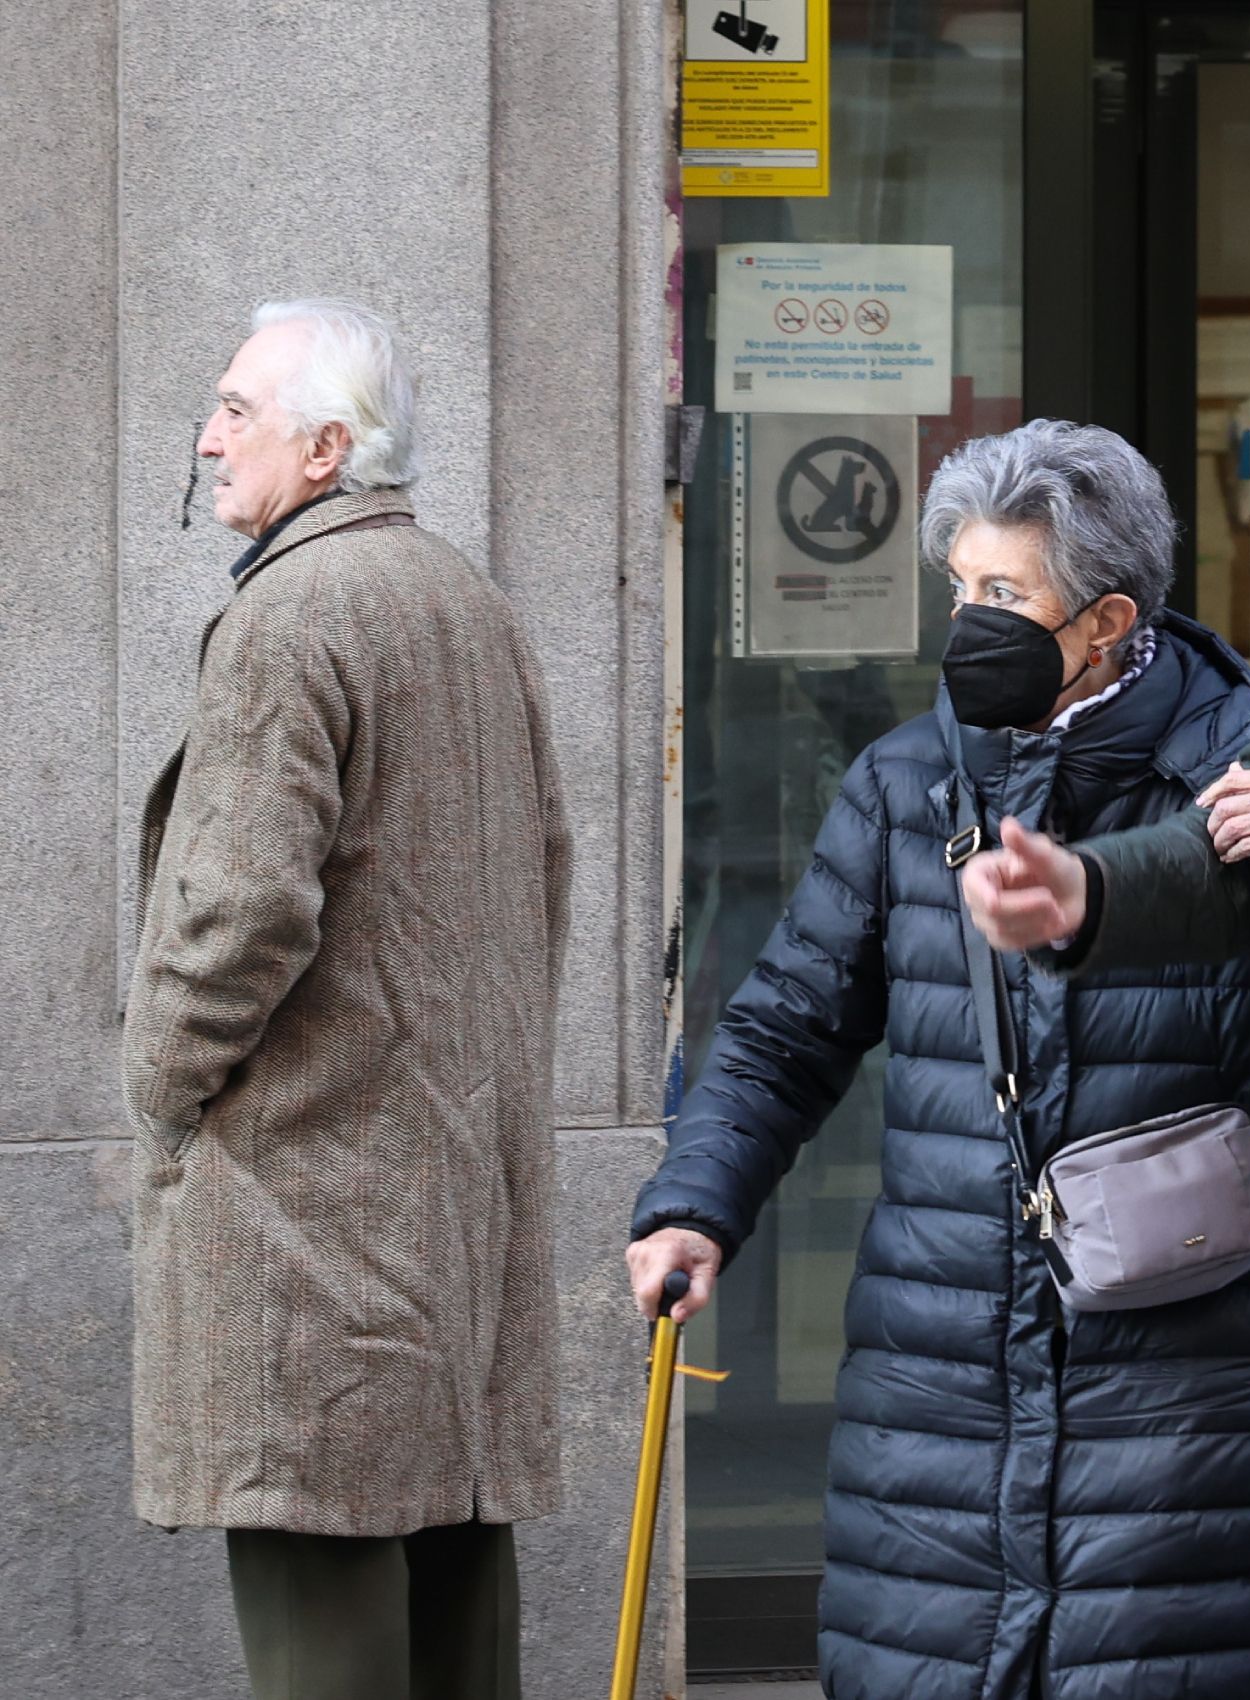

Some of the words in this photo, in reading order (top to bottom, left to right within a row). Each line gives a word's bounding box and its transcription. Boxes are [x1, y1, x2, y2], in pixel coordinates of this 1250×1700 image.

[761, 280, 782, 291] Por
[798, 281, 854, 294] seguridad
[857, 281, 871, 292] de
[874, 282, 907, 293] todos
[811, 369, 850, 381] Centro
[870, 370, 903, 381] Salud
